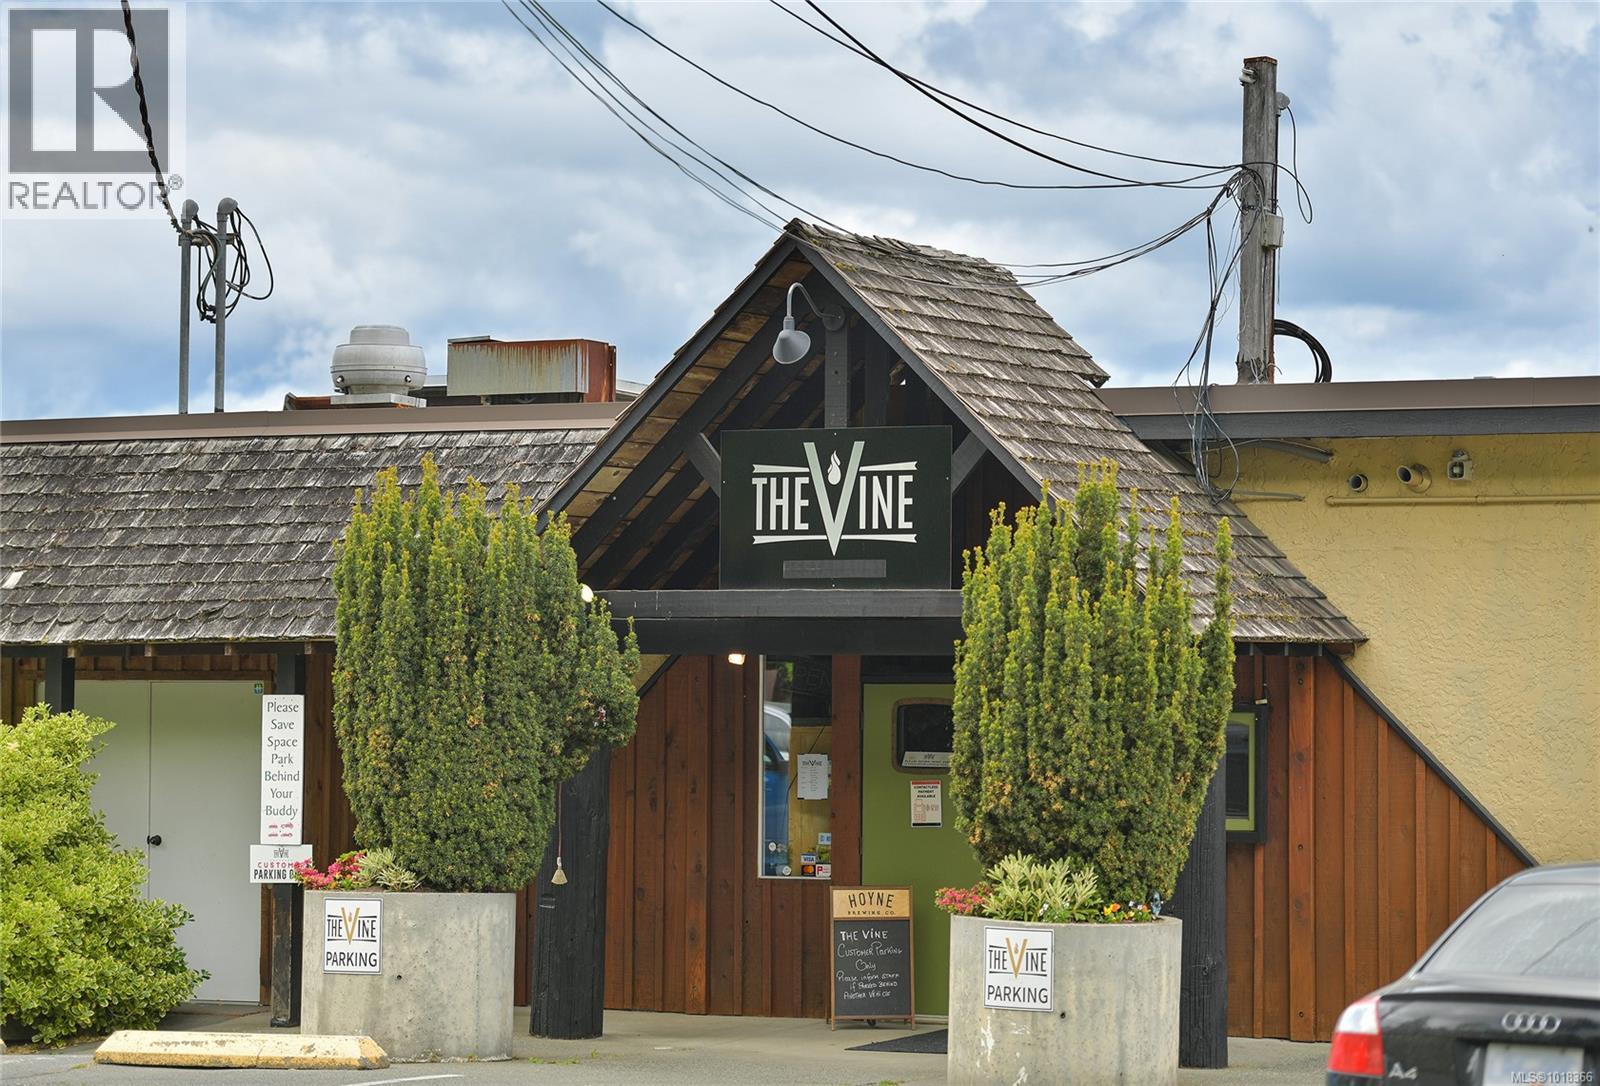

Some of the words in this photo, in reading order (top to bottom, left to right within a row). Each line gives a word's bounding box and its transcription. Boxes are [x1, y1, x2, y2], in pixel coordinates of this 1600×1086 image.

[752, 477, 810, 531] THE
[803, 440, 914, 557] VINE
[267, 701, 299, 713] Please
[270, 718, 295, 730] Save
[267, 736, 298, 751] Space
[271, 753, 293, 764] Park
[264, 770, 300, 781] Behind
[270, 788, 293, 799] Your
[265, 805, 298, 820] Buddy
[253, 869, 287, 880] PARKING
[848, 891, 895, 909] HOYNE
[326, 918, 343, 938] THE
[340, 907, 377, 945] VINE
[840, 930, 859, 941] THE
[325, 951, 378, 968] PARKING
[988, 949, 1007, 970] THE
[1005, 937, 1047, 979] VINE
[987, 984, 1048, 1004] PARKING
[1387, 1062, 1418, 1080] A4
